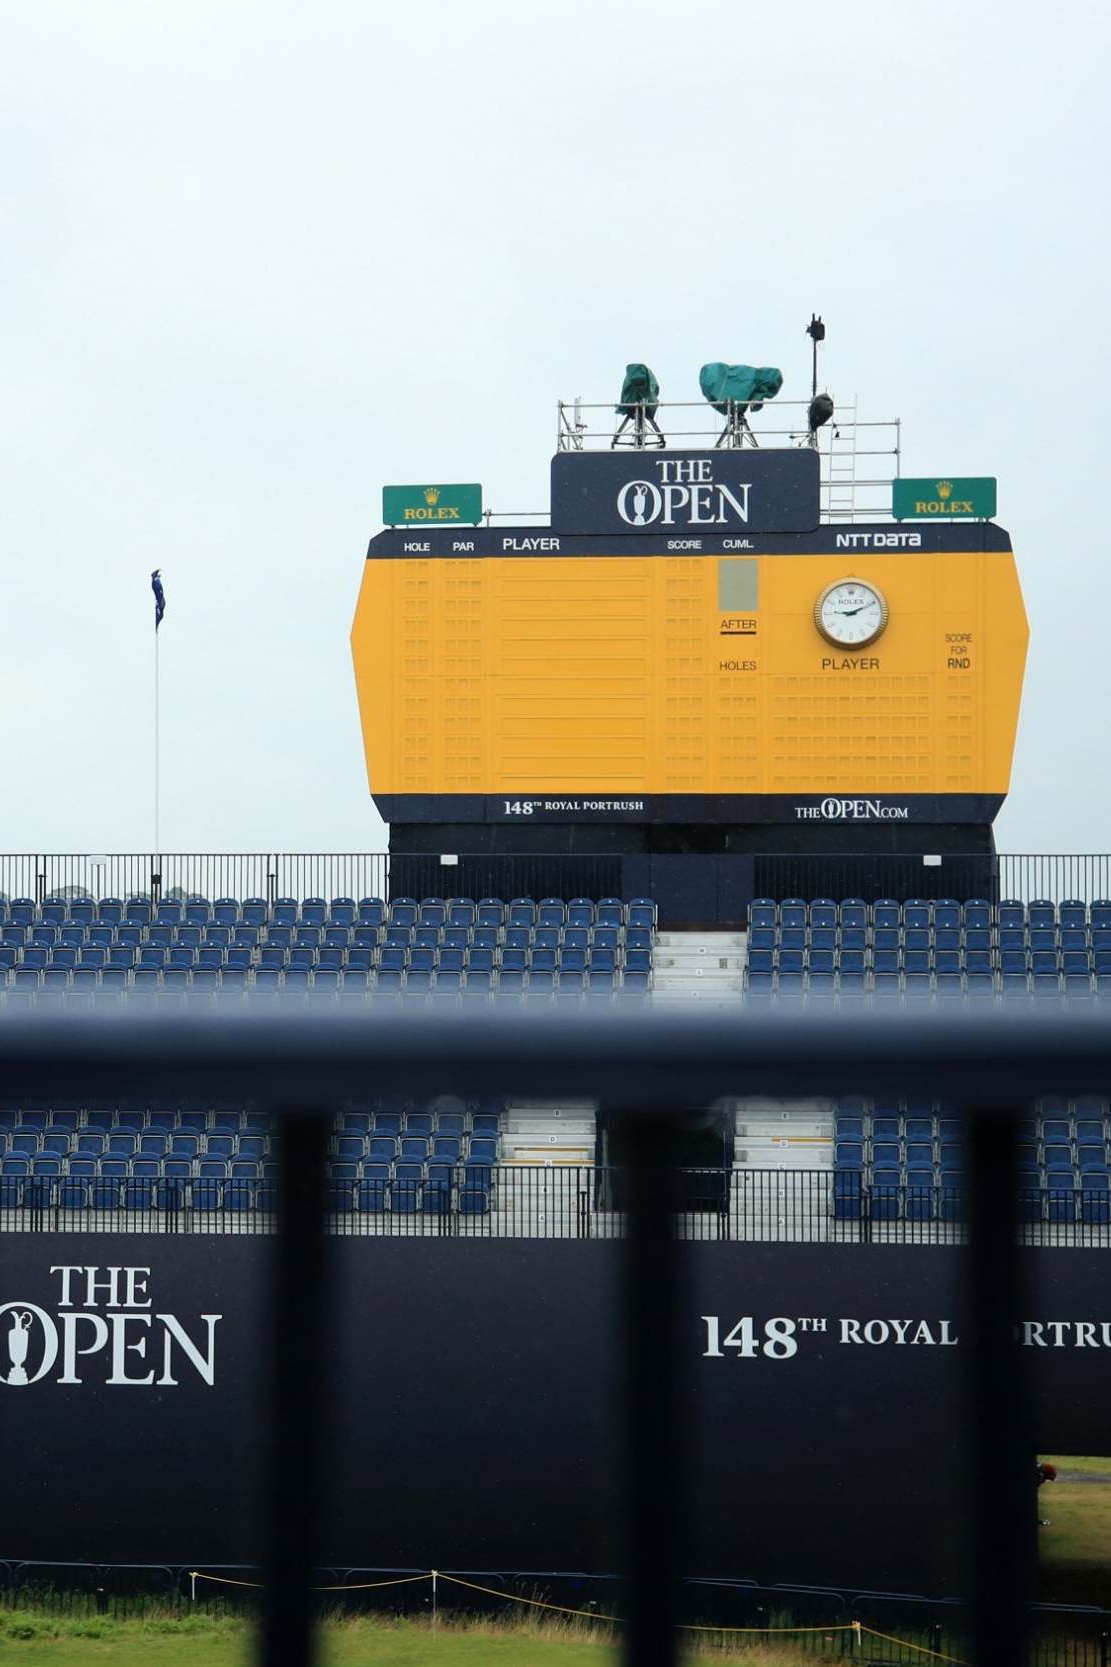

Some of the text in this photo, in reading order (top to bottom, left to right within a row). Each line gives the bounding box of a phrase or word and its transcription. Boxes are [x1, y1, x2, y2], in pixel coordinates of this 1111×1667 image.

[656, 459, 714, 482] THE
[616, 480, 752, 525] OPEN
[915, 501, 974, 513] ROLEX
[404, 507, 460, 520] ROLEX
[502, 537, 560, 551] PLAYER
[667, 539, 702, 550] SCORE
[836, 533, 876, 548] NTT
[404, 542, 431, 552] HOLE
[452, 542, 474, 552] PAR
[720, 619, 757, 629] AFTER
[945, 633, 973, 643] SCORE
[950, 646, 968, 655] FOR
[719, 660, 757, 671] HOLES
[822, 658, 880, 671] PLAYER
[947, 658, 971, 669] RND
[544, 801, 581, 810] ROYAL
[583, 801, 644, 810] PORTRUSH
[50, 1265, 152, 1310] THE
[701, 1315, 827, 1359] 148TH
[838, 1318, 958, 1345] ROYAL
